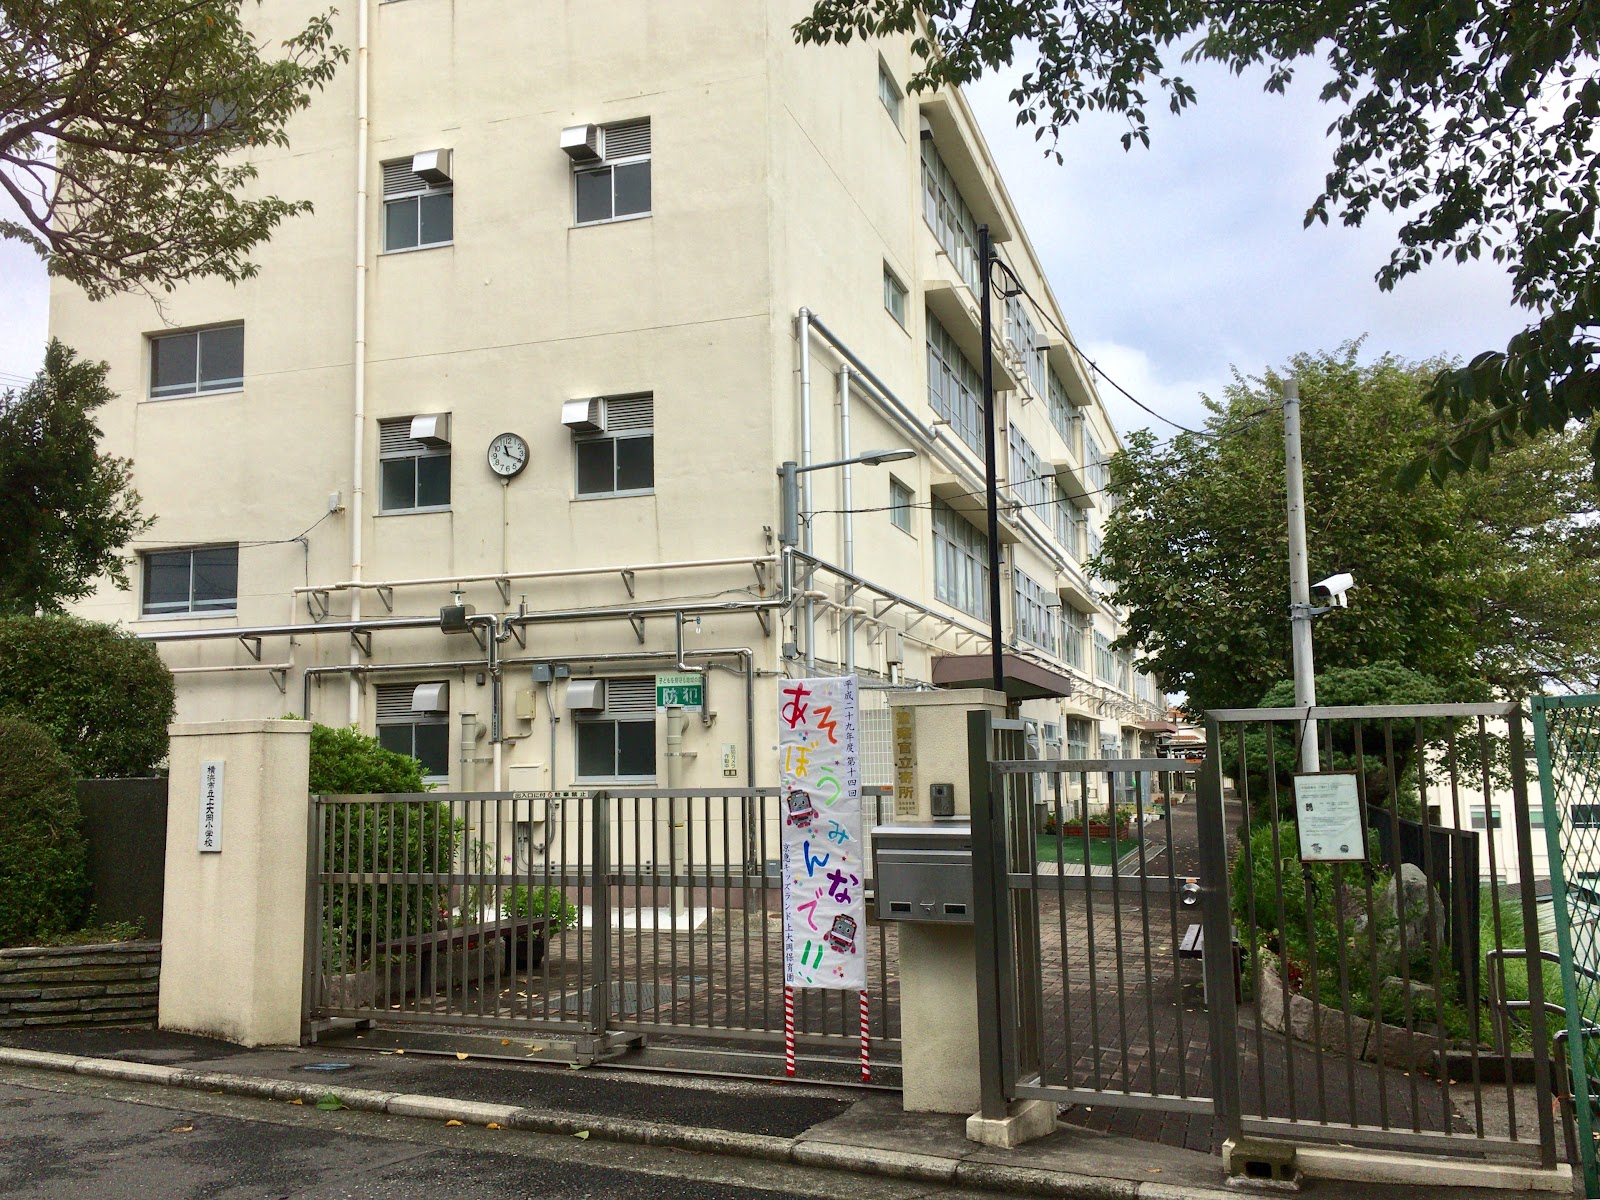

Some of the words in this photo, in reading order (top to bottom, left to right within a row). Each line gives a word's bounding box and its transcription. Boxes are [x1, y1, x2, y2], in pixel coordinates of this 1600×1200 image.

[662, 687, 698, 704] 防犯
[843, 679, 856, 753] 平成二十九年度
[203, 765, 216, 848] 横浜市立上大岡小学校
